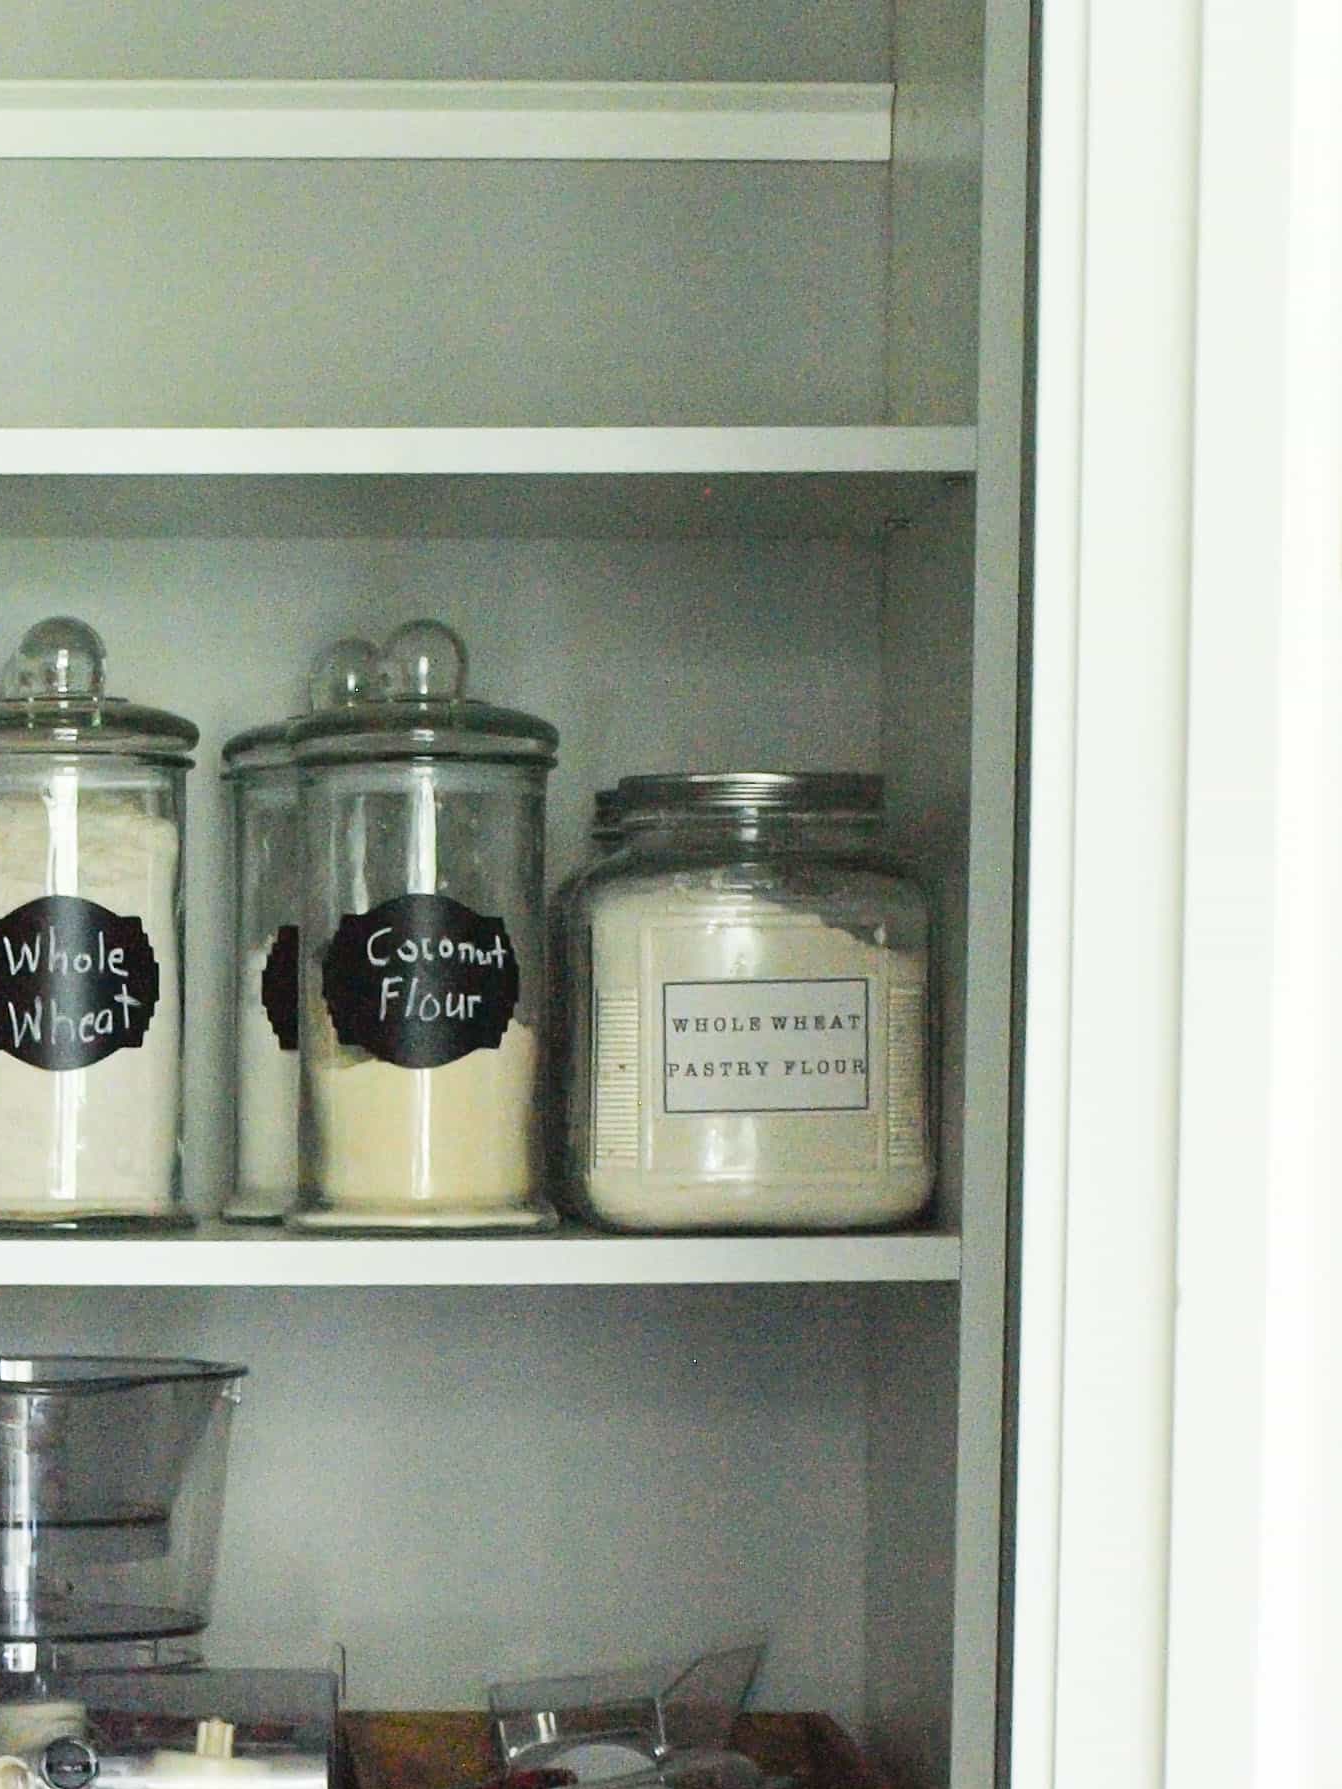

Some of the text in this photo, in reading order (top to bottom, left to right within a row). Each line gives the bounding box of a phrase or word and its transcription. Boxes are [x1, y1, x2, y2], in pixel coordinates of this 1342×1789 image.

[2, 926, 130, 977] Whole
[366, 926, 507, 969] Coconut
[8, 983, 142, 1049] Wheat
[379, 976, 483, 1022] Flour
[671, 1014, 862, 1034] WHOLE WHEAT
[668, 1058, 867, 1078] PASTRY FLOUR
